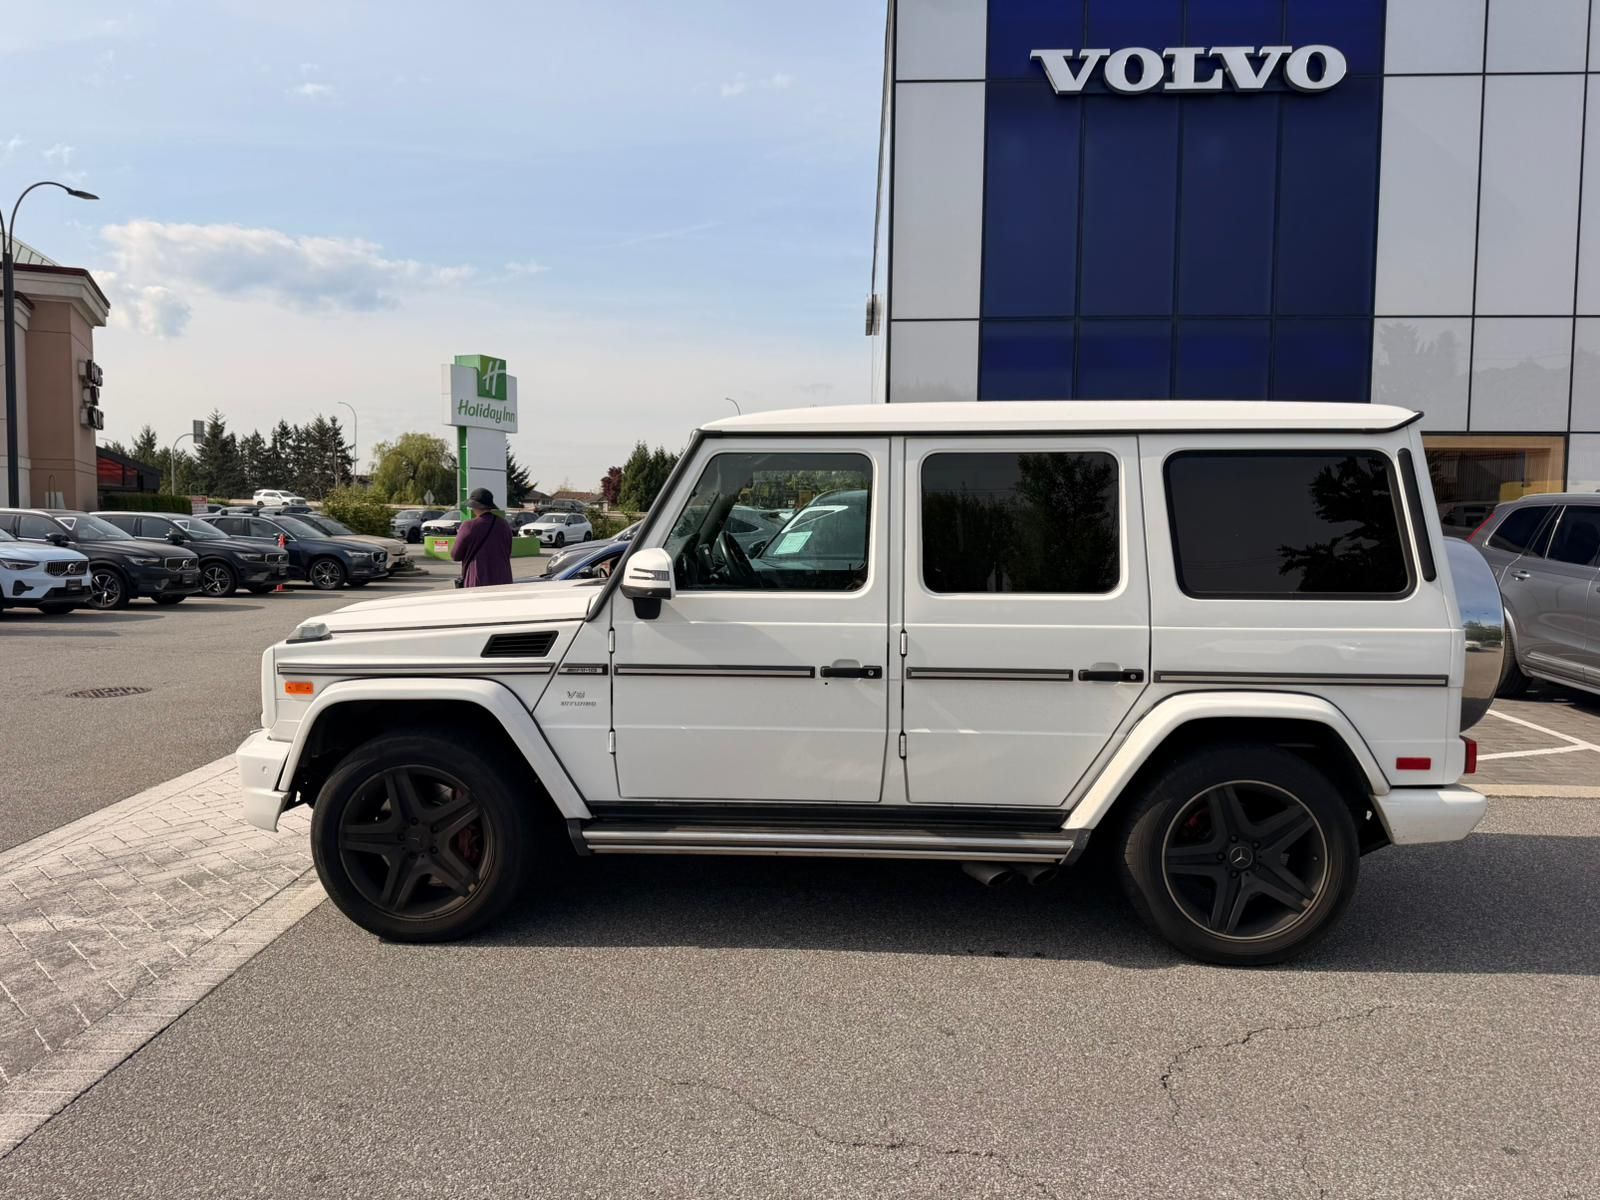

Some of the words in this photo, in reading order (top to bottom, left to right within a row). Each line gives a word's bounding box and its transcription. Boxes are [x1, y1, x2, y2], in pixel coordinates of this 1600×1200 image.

[1029, 45, 1347, 94] VOLVO
[457, 399, 502, 424] Holiday
[503, 405, 515, 423] Inn
